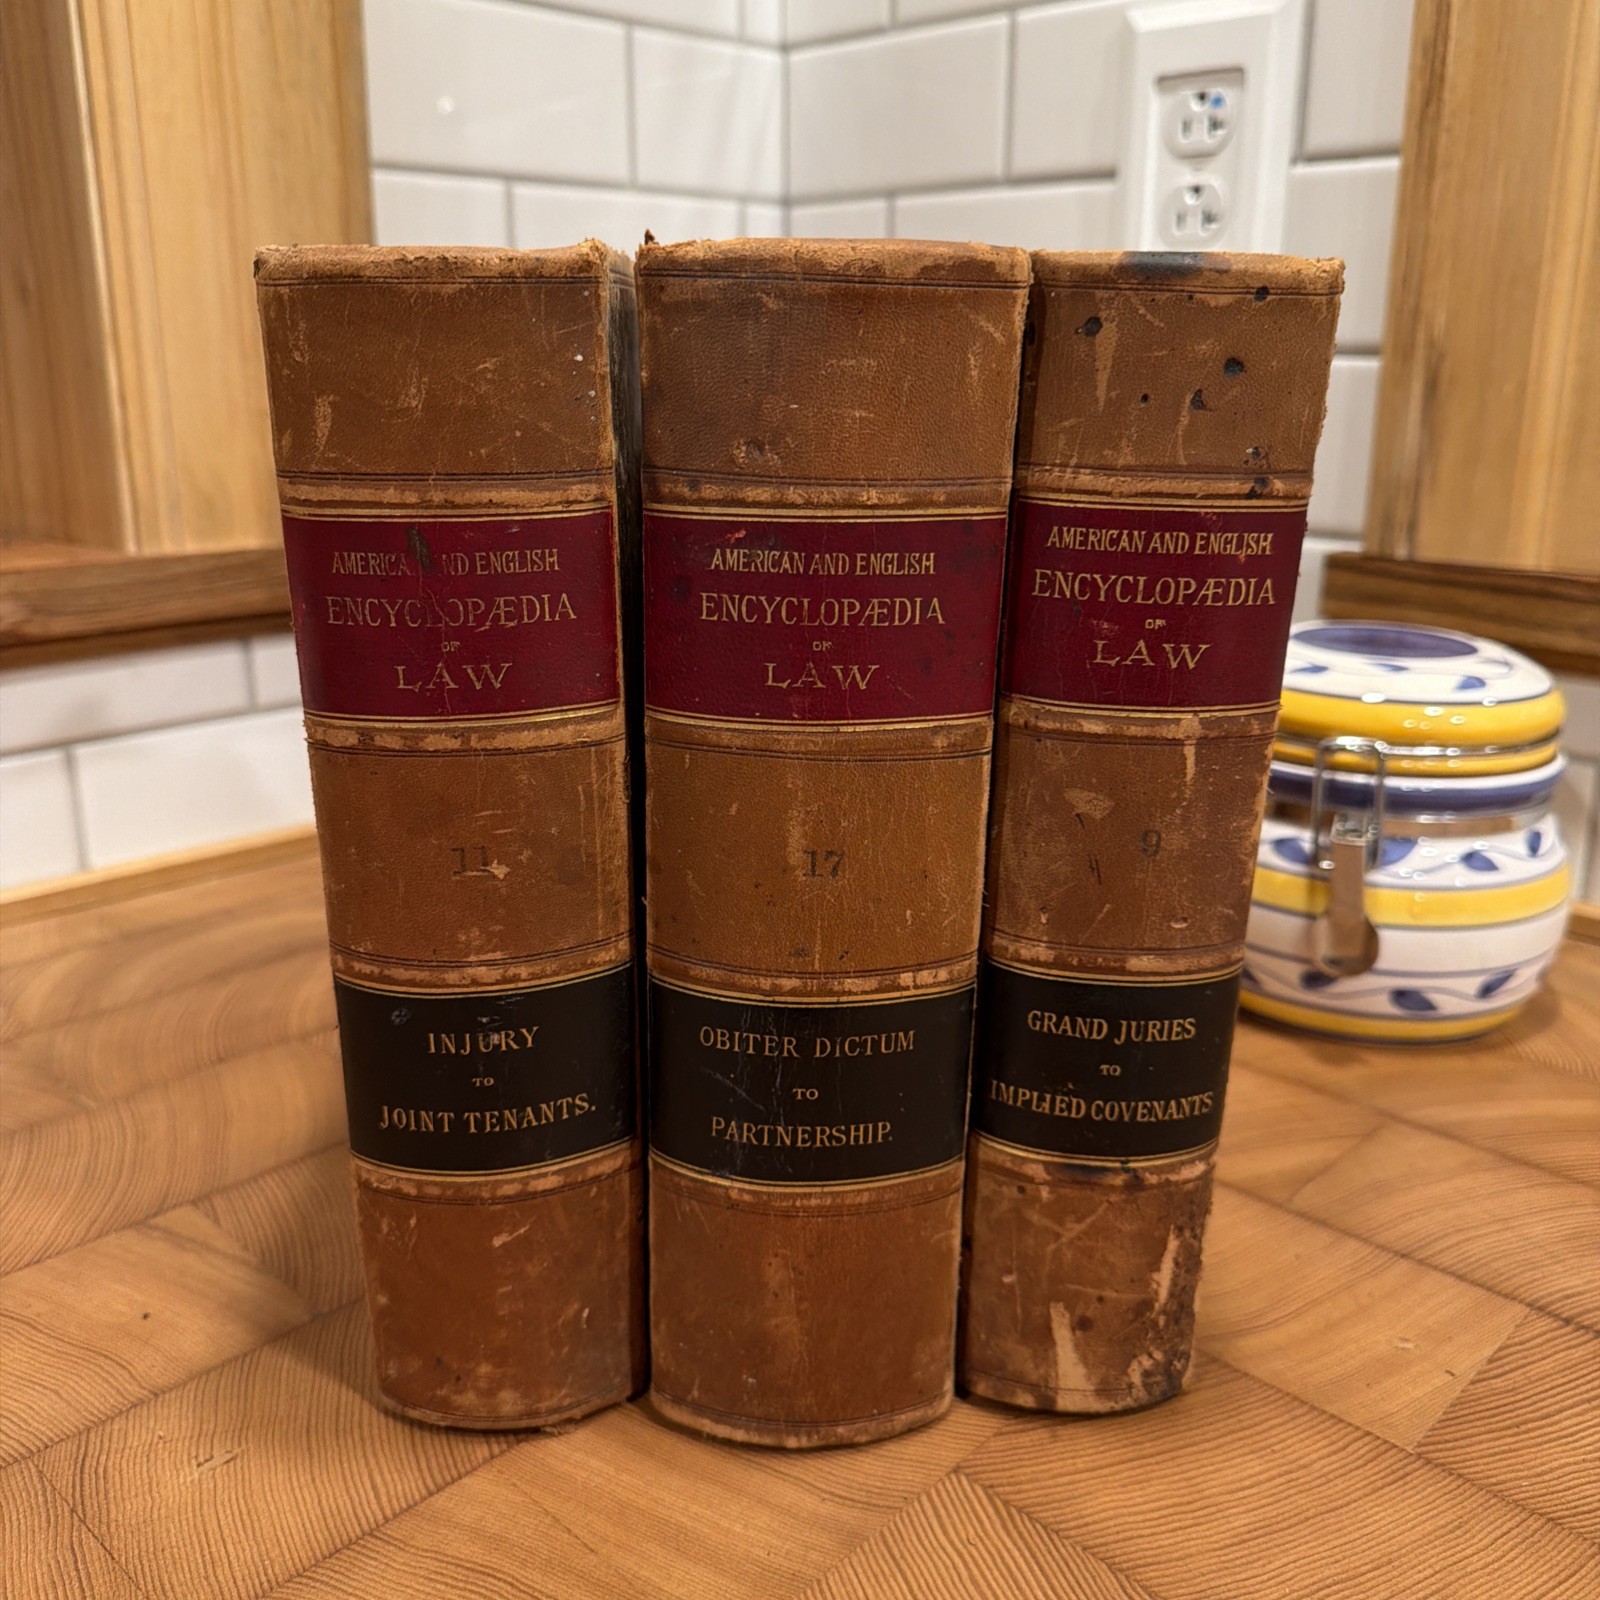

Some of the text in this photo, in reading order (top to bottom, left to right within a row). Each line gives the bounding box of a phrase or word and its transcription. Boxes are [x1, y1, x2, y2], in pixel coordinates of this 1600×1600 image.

[1046, 525, 1274, 556] AMERICAN AND ENGLISH
[331, 548, 561, 576] AMERICA ND ENGLISH
[707, 548, 936, 576] AMERICAN AND ENGLISH
[1031, 568, 1276, 606] ENCYCLOPÆDIA
[325, 592, 578, 628] ENCYCLOPÆDIA
[699, 592, 947, 627] ENCYCLOPÆDIA
[1145, 618, 1167, 630] OF
[441, 640, 461, 652] OF
[812, 640, 832, 652] OF
[1092, 638, 1212, 670] LAW
[393, 661, 513, 692] LAW
[764, 661, 880, 691] LAW
[1140, 828, 1162, 860] 9
[449, 845, 495, 878] 11
[802, 850, 846, 879] 17
[427, 1026, 541, 1056] INJURY
[699, 1025, 916, 1059] OBITER DICTUM
[1027, 1010, 1198, 1045] GRAND JURIES
[471, 1076, 494, 1087] TO
[1099, 1063, 1121, 1076] TO
[792, 1087, 820, 1101] TO
[990, 1080, 1215, 1123] IMPLIED COVENANTS
[379, 1092, 597, 1134] JOINT TENANTS.
[710, 1116, 894, 1148] PARTNERSHIP.
